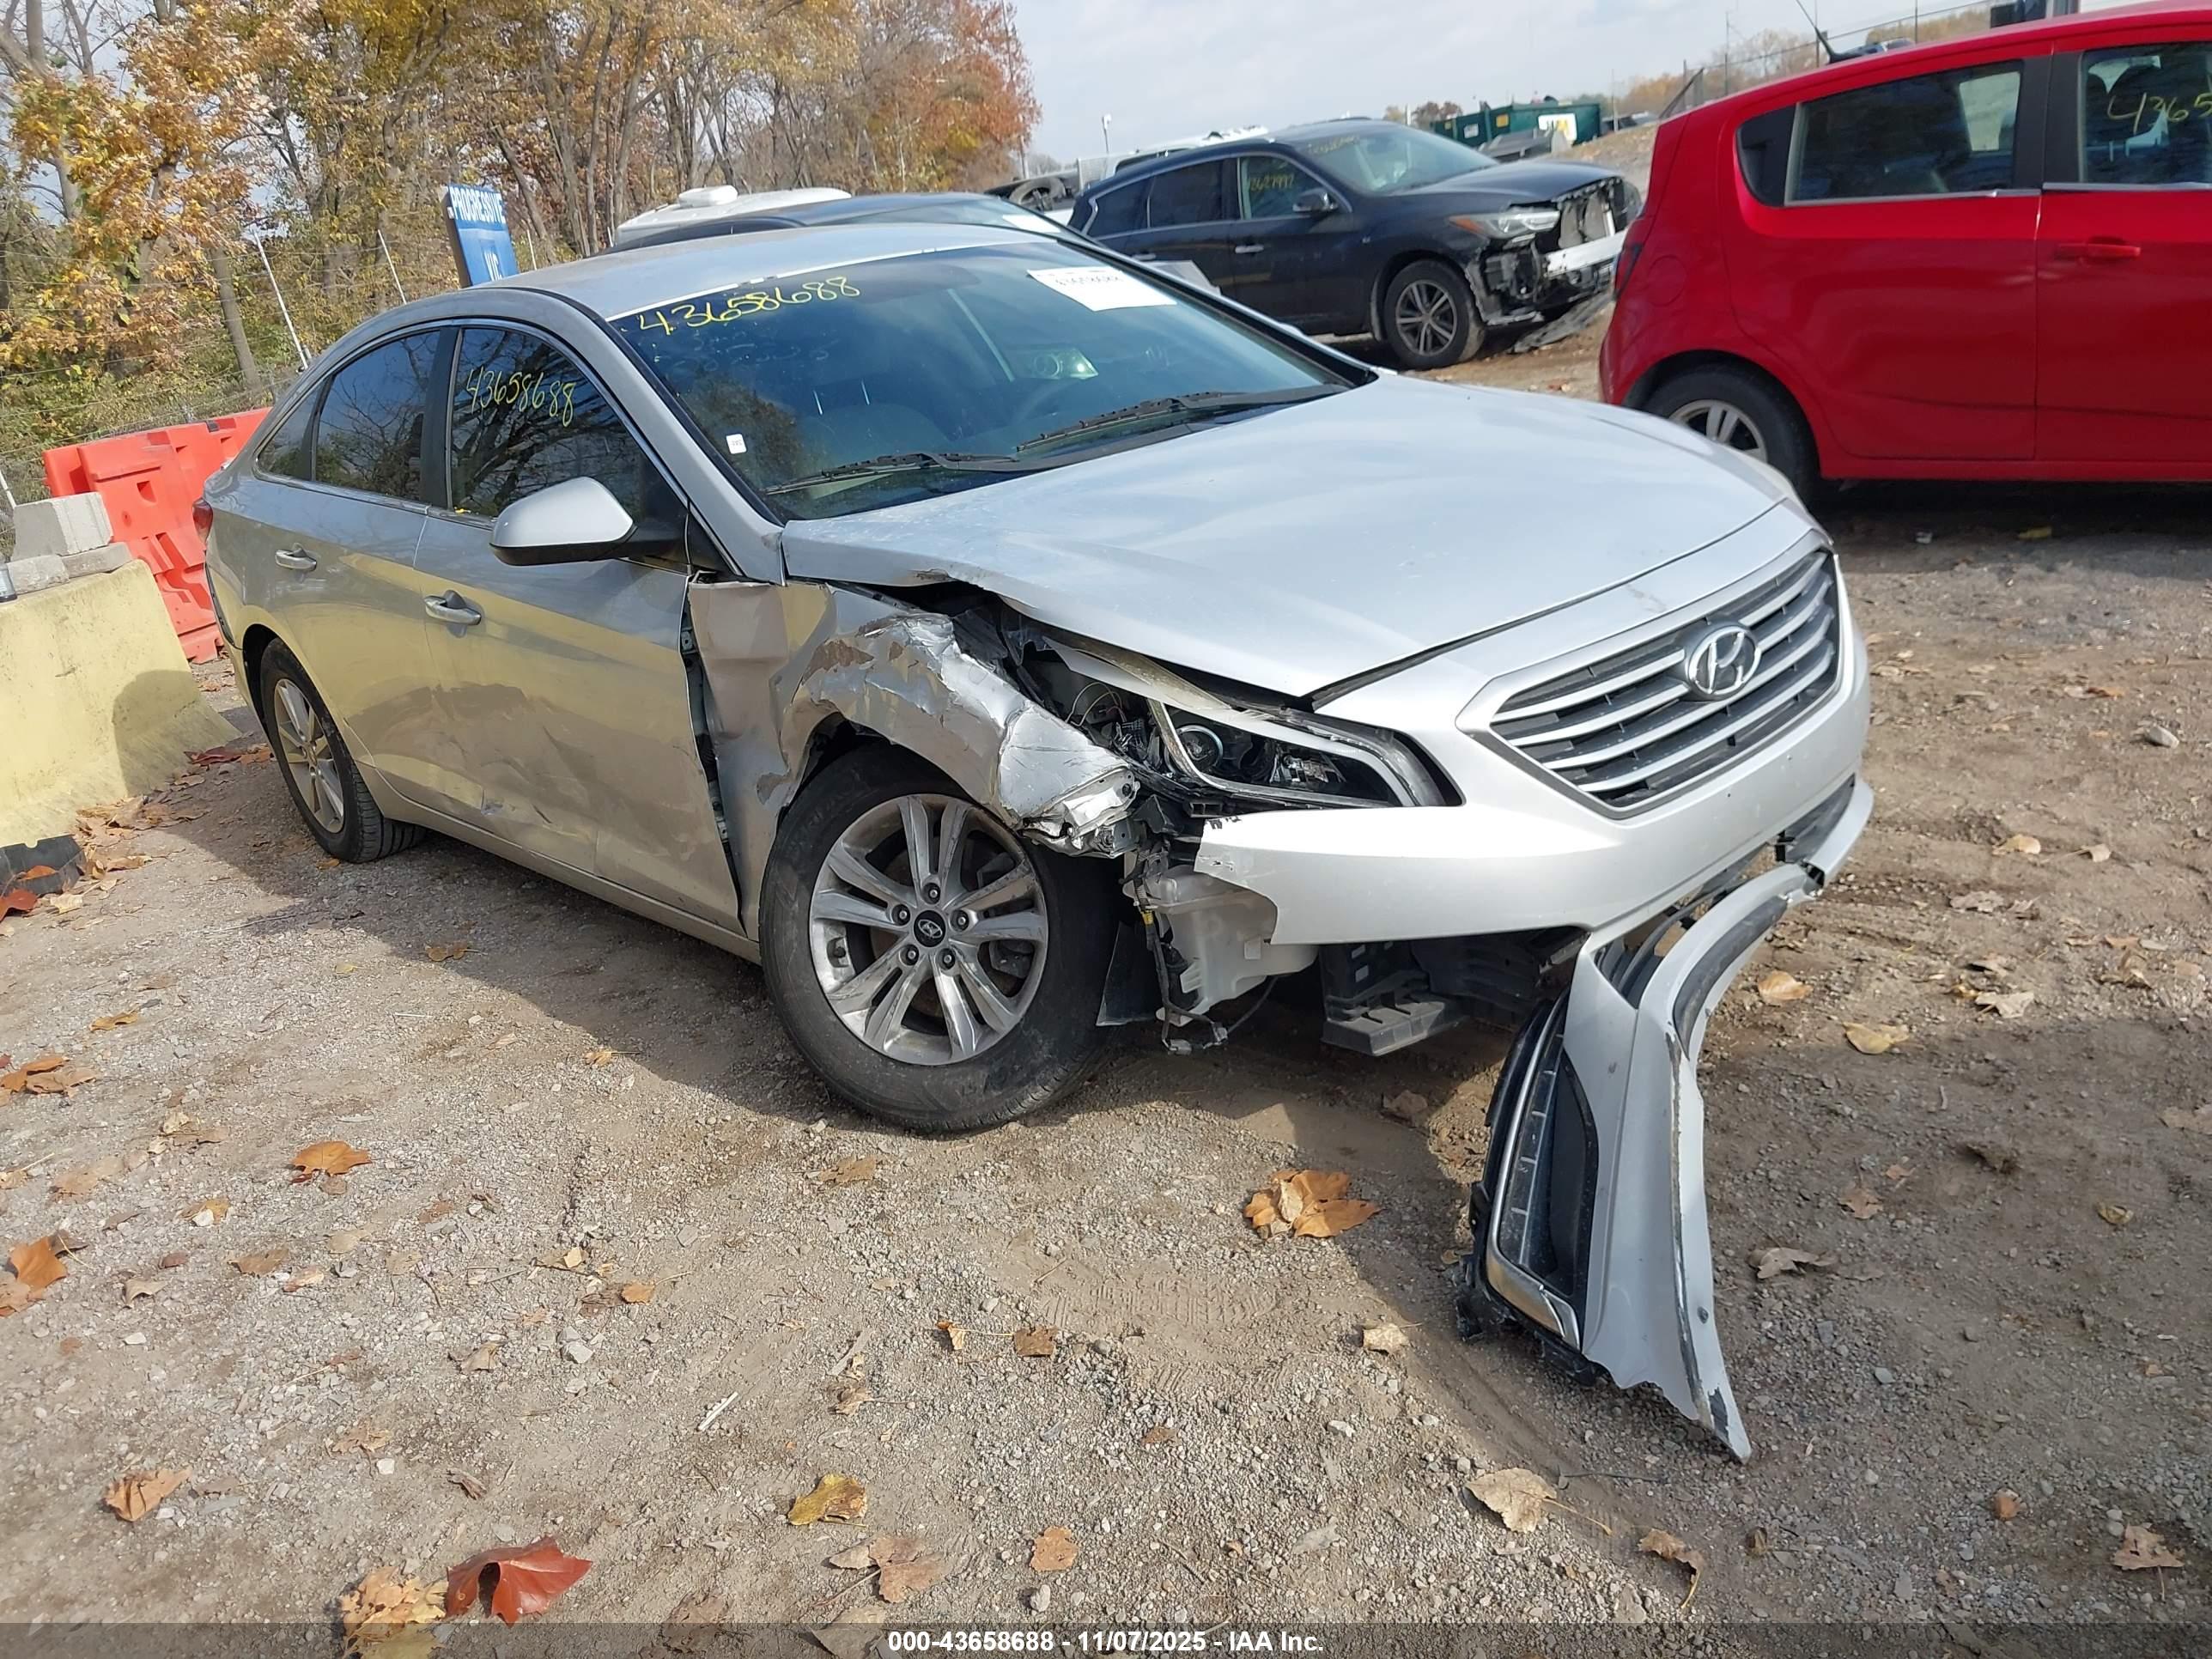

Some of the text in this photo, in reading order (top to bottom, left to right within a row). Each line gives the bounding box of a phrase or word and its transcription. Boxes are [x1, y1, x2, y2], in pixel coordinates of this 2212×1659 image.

[449, 185, 506, 224] PROGRESSIVE
[639, 276, 860, 336] 43658688
[465, 366, 577, 428] 43658688
